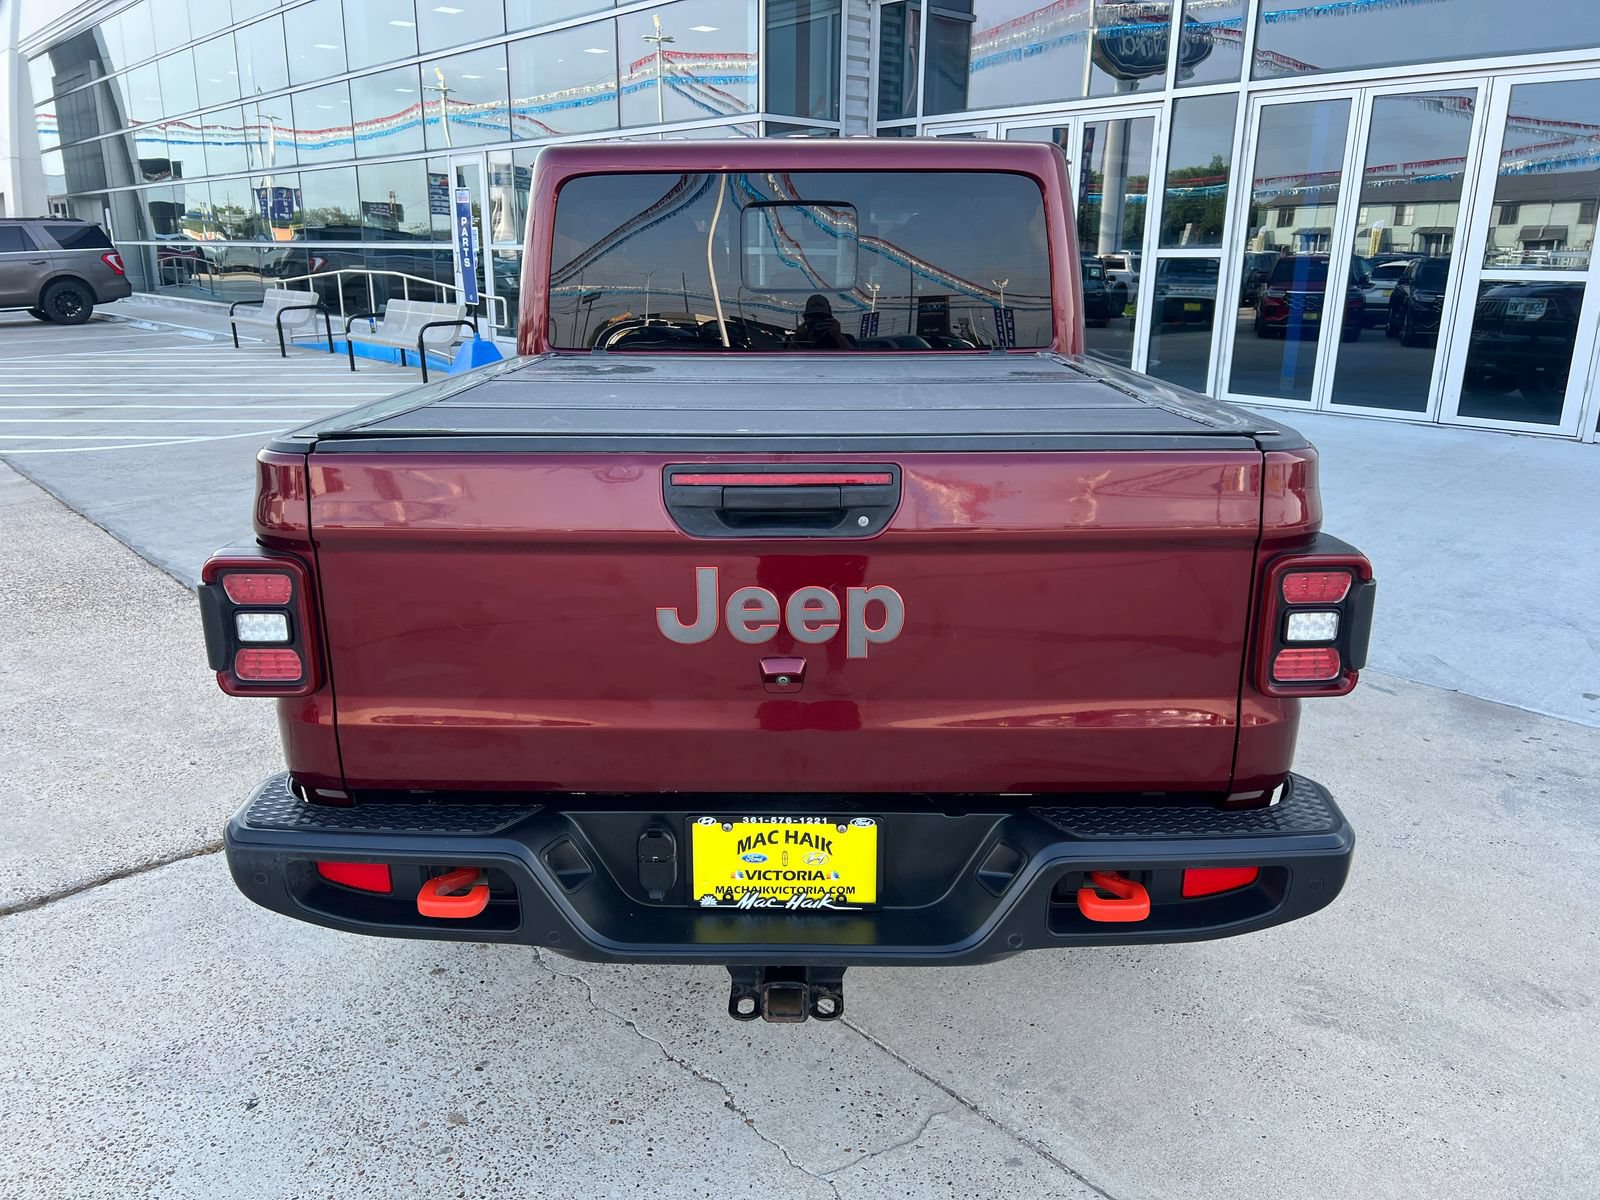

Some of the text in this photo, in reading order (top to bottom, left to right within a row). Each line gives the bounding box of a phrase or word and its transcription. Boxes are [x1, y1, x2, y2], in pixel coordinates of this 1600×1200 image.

[460, 216, 471, 268] PARTS
[655, 566, 906, 659] Jeep
[742, 816, 828, 824] 361-576-1221
[852, 818, 873, 827] Ford
[737, 830, 833, 856] MAC HAIK
[743, 854, 766, 863] Ford
[745, 870, 826, 881] VICTORIA
[715, 885, 856, 895] MACHAIKVICTORIACOM
[736, 891, 838, 910] Mac Haik
